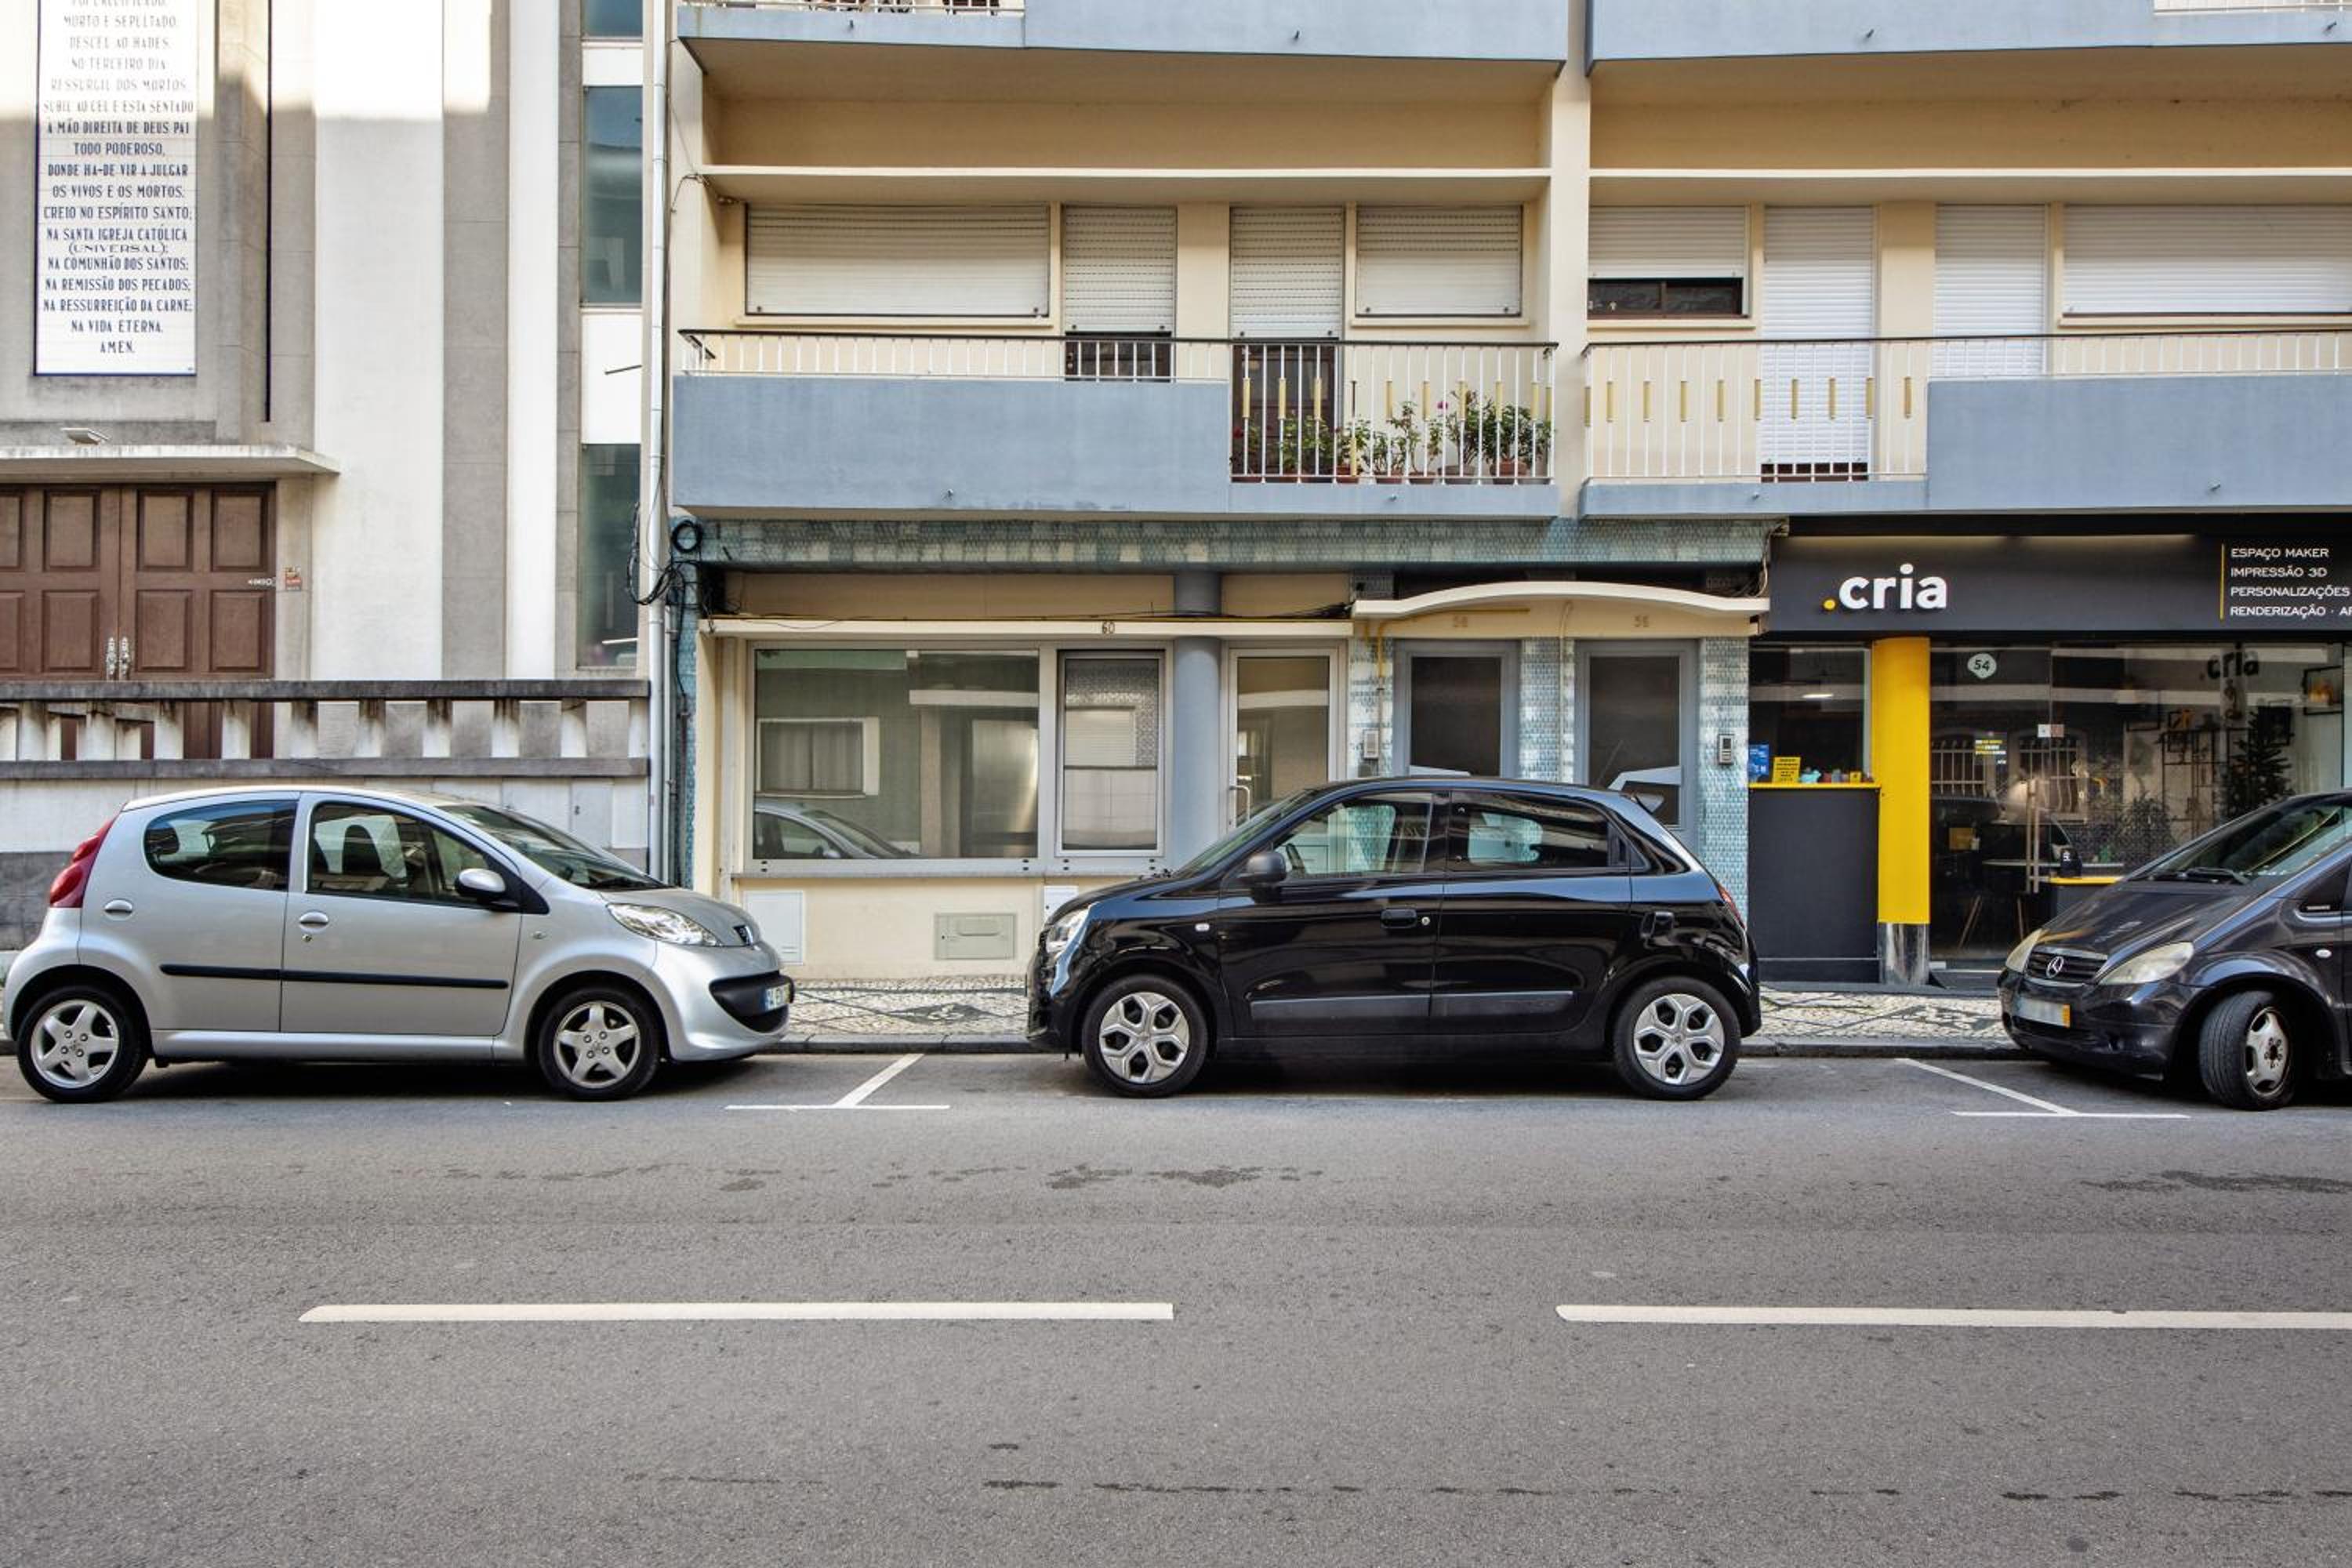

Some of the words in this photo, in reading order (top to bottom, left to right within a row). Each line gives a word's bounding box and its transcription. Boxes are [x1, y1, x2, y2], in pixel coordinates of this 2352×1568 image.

[83, 122, 122, 134] DIREITA
[127, 122, 137, 134] DE
[144, 122, 169, 134] DEUS
[173, 122, 189, 134] PAI
[74, 143, 101, 155] TODO
[48, 164, 78, 176] DONDE
[120, 164, 136, 176] VIR
[151, 164, 188, 176] JULGAR
[53, 185, 67, 198] OS
[72, 185, 102, 198] VIVOS
[107, 185, 114, 198] E
[118, 185, 132, 198] OS
[44, 207, 75, 219] CREIO
[81, 207, 93, 219] NO
[47, 228, 58, 241] NA
[64, 228, 93, 241] SANTA
[98, 228, 133, 241] IGREJA
[48, 257, 60, 270] NA
[64, 255, 121, 270] COMUNHÃO
[124, 257, 143, 270] DOS
[45, 278, 56, 291] NA
[63, 275, 114, 291] REMISSÃO
[119, 278, 138, 291] DOS
[43, 299, 55, 311] NA
[60, 296, 136, 314] RESSURREIÇÃO
[141, 299, 152, 311] DA
[71, 320, 83, 332] NA
[89, 320, 112, 332] VIDA
[2231, 548, 2281, 560] ESPAÇO
[2285, 548, 2329, 557] MAKER
[2230, 565, 2304, 577] IMPRESSÃO
[2308, 567, 2328, 577] 3D
[2230, 586, 2350, 599] PERSONALIZAÇÕES
[2230, 604, 2326, 619] RENDERIZAÇÃO
[1102, 621, 1115, 634] 60
[1974, 659, 1990, 672] 54
